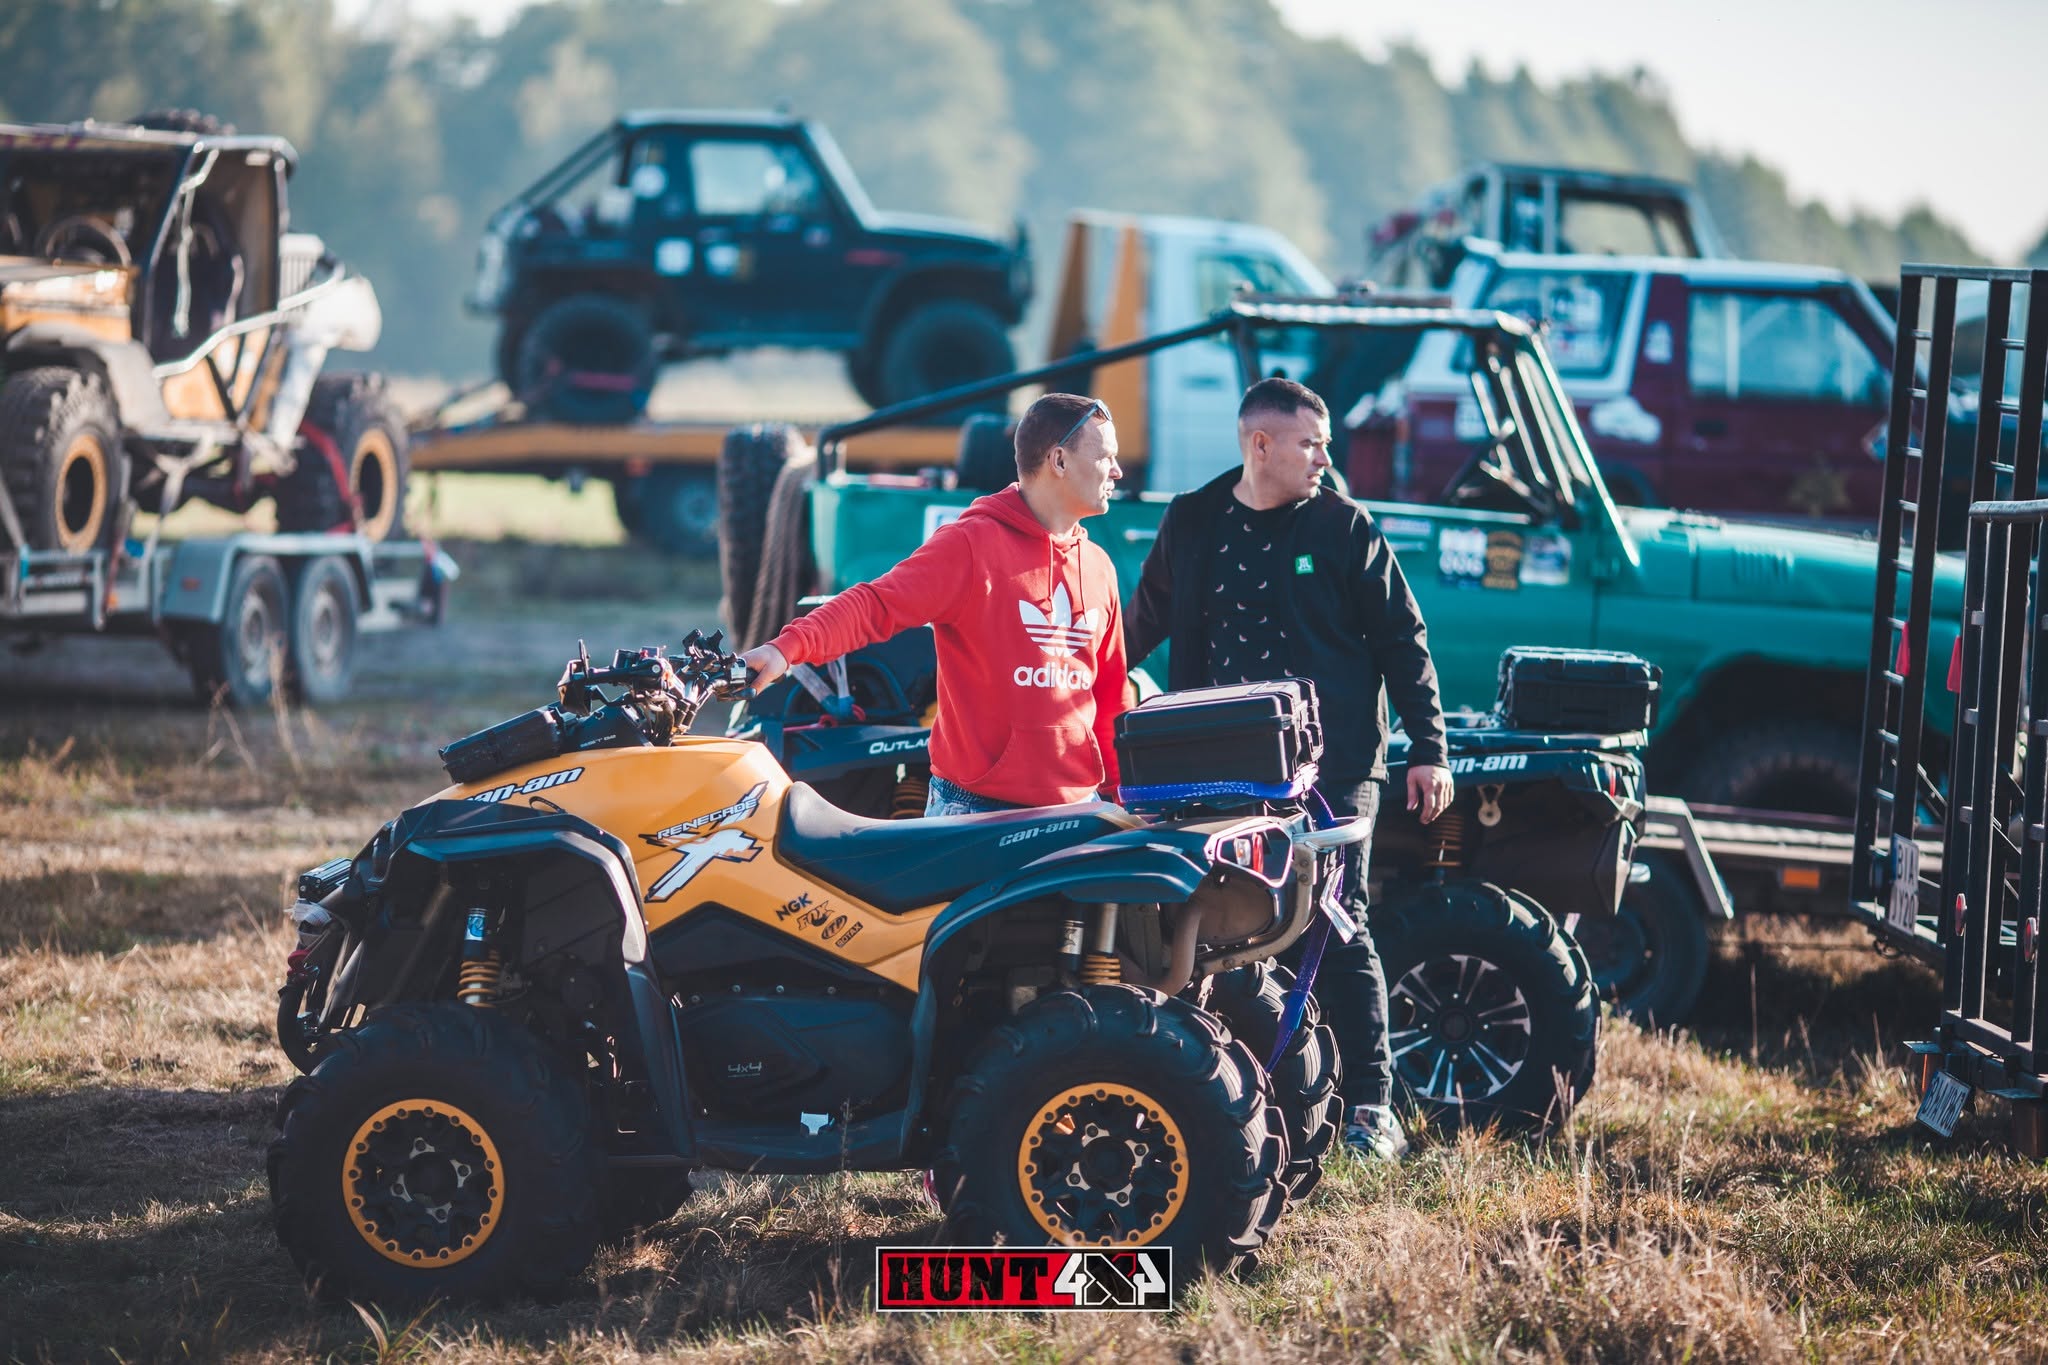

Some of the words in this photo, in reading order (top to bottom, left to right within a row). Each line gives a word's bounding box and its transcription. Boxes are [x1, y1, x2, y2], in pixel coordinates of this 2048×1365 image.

[1013, 661, 1092, 691] adidas
[1448, 754, 1528, 774] an-am
[463, 766, 586, 803] an-am
[657, 799, 758, 840] RENEGADE
[998, 819, 1081, 848] can-am
[775, 892, 813, 922] NGK
[796, 900, 835, 931] FOX
[727, 1061, 763, 1073] 4x4
